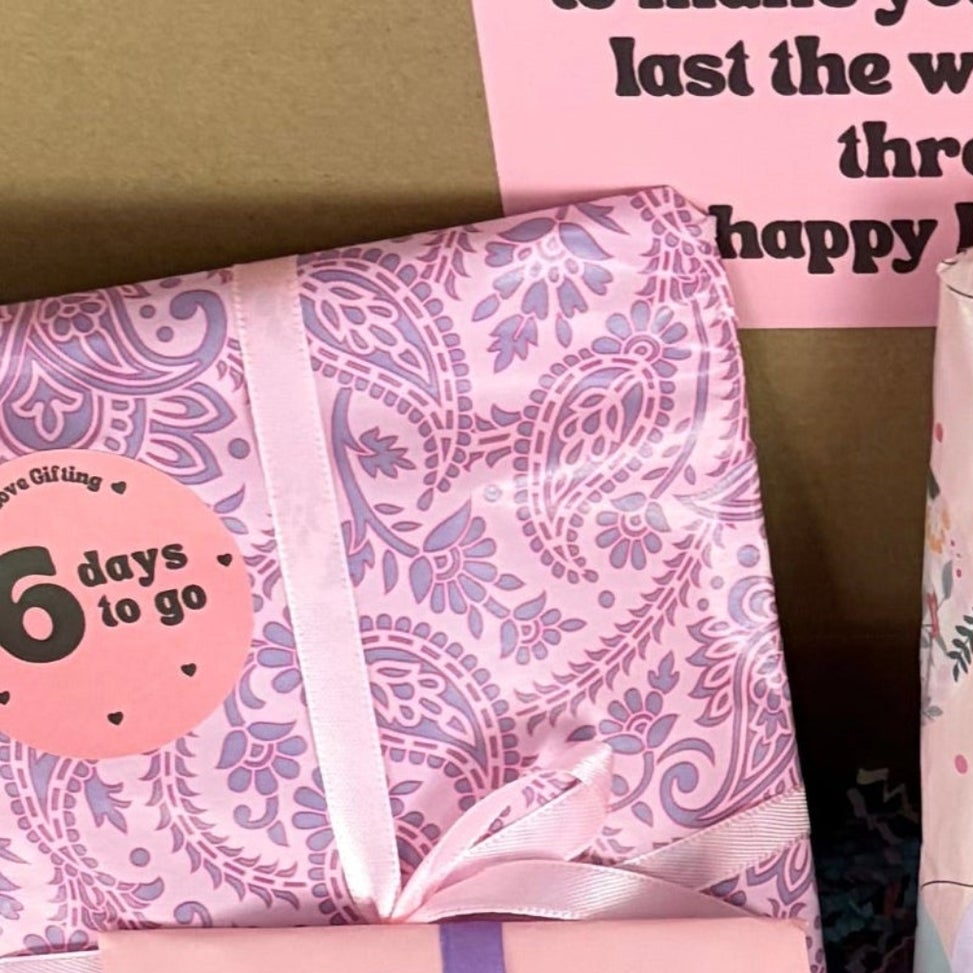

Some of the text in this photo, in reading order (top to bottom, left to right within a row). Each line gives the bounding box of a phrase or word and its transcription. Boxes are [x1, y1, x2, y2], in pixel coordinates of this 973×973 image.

[610, 37, 754, 96] last
[770, 36, 892, 95] the
[708, 204, 938, 274] happy
[0, 466, 102, 510] ove Gifting
[78, 544, 187, 587] days
[0, 546, 86, 663] 6
[98, 585, 206, 627] to go
